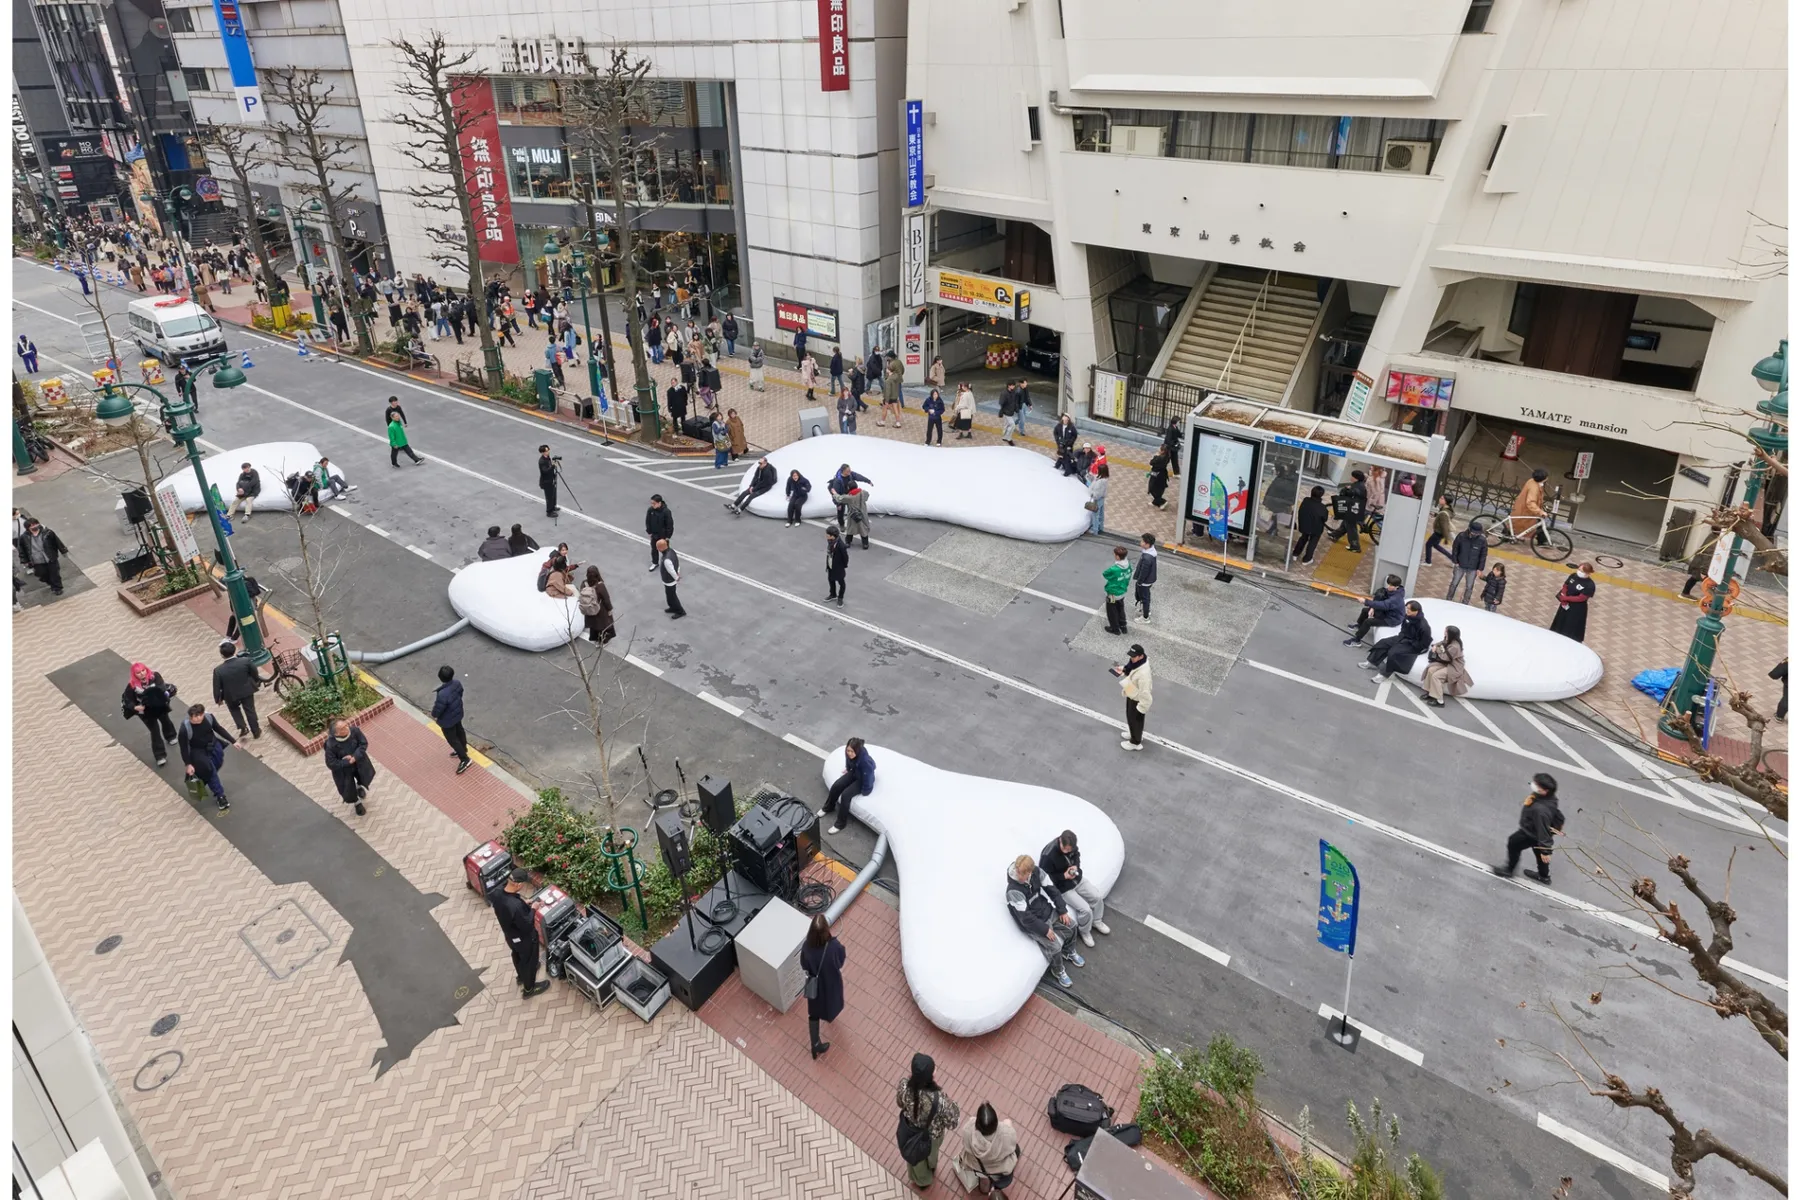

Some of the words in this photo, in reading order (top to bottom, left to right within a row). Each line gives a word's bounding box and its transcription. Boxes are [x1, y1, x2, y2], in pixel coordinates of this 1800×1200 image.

[496, 35, 587, 75] 無印良品
[830, 0, 846, 76] 無印良品
[244, 96, 258, 113] P
[531, 147, 562, 164] MUJI
[908, 134, 918, 201] 東京山手教会
[470, 136, 504, 242] 無印良品
[1142, 222, 1306, 254] 東京山手教会
[912, 229, 923, 295] BUZZ
[1520, 406, 1573, 425] YAMATE
[1579, 419, 1629, 435] mansion
